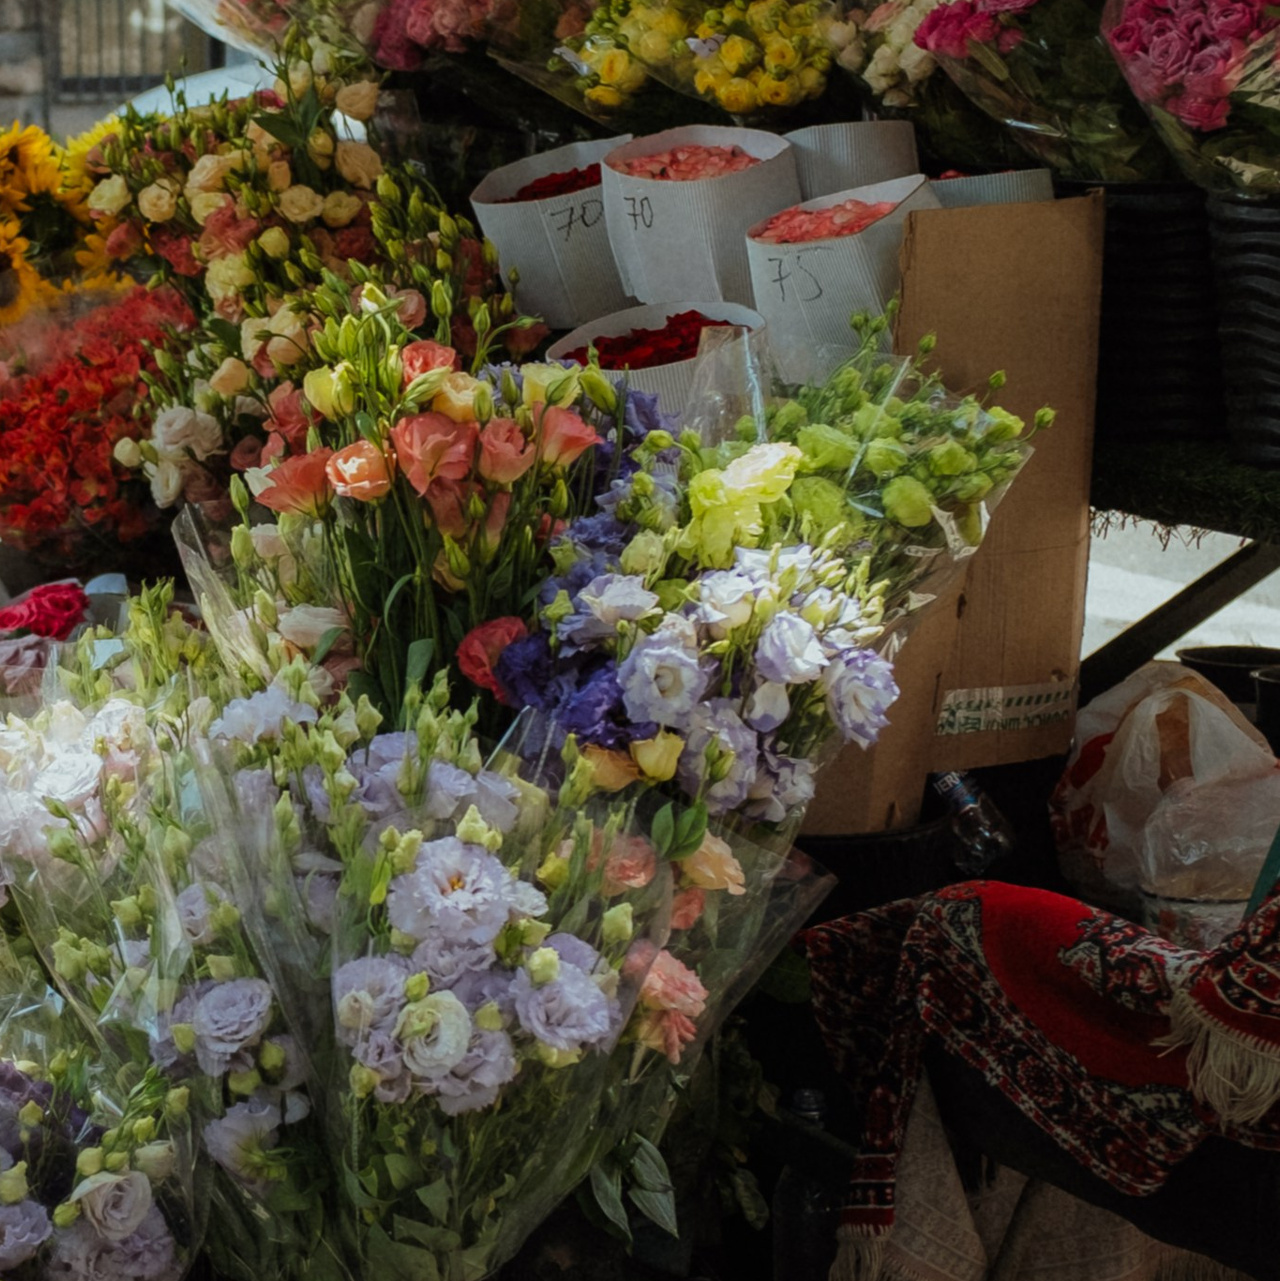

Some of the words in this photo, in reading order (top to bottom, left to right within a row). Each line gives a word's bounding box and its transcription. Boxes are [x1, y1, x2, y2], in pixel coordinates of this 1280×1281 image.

[550, 199, 604, 242] 70
[624, 196, 653, 230] 70
[768, 246, 834, 302] 75
